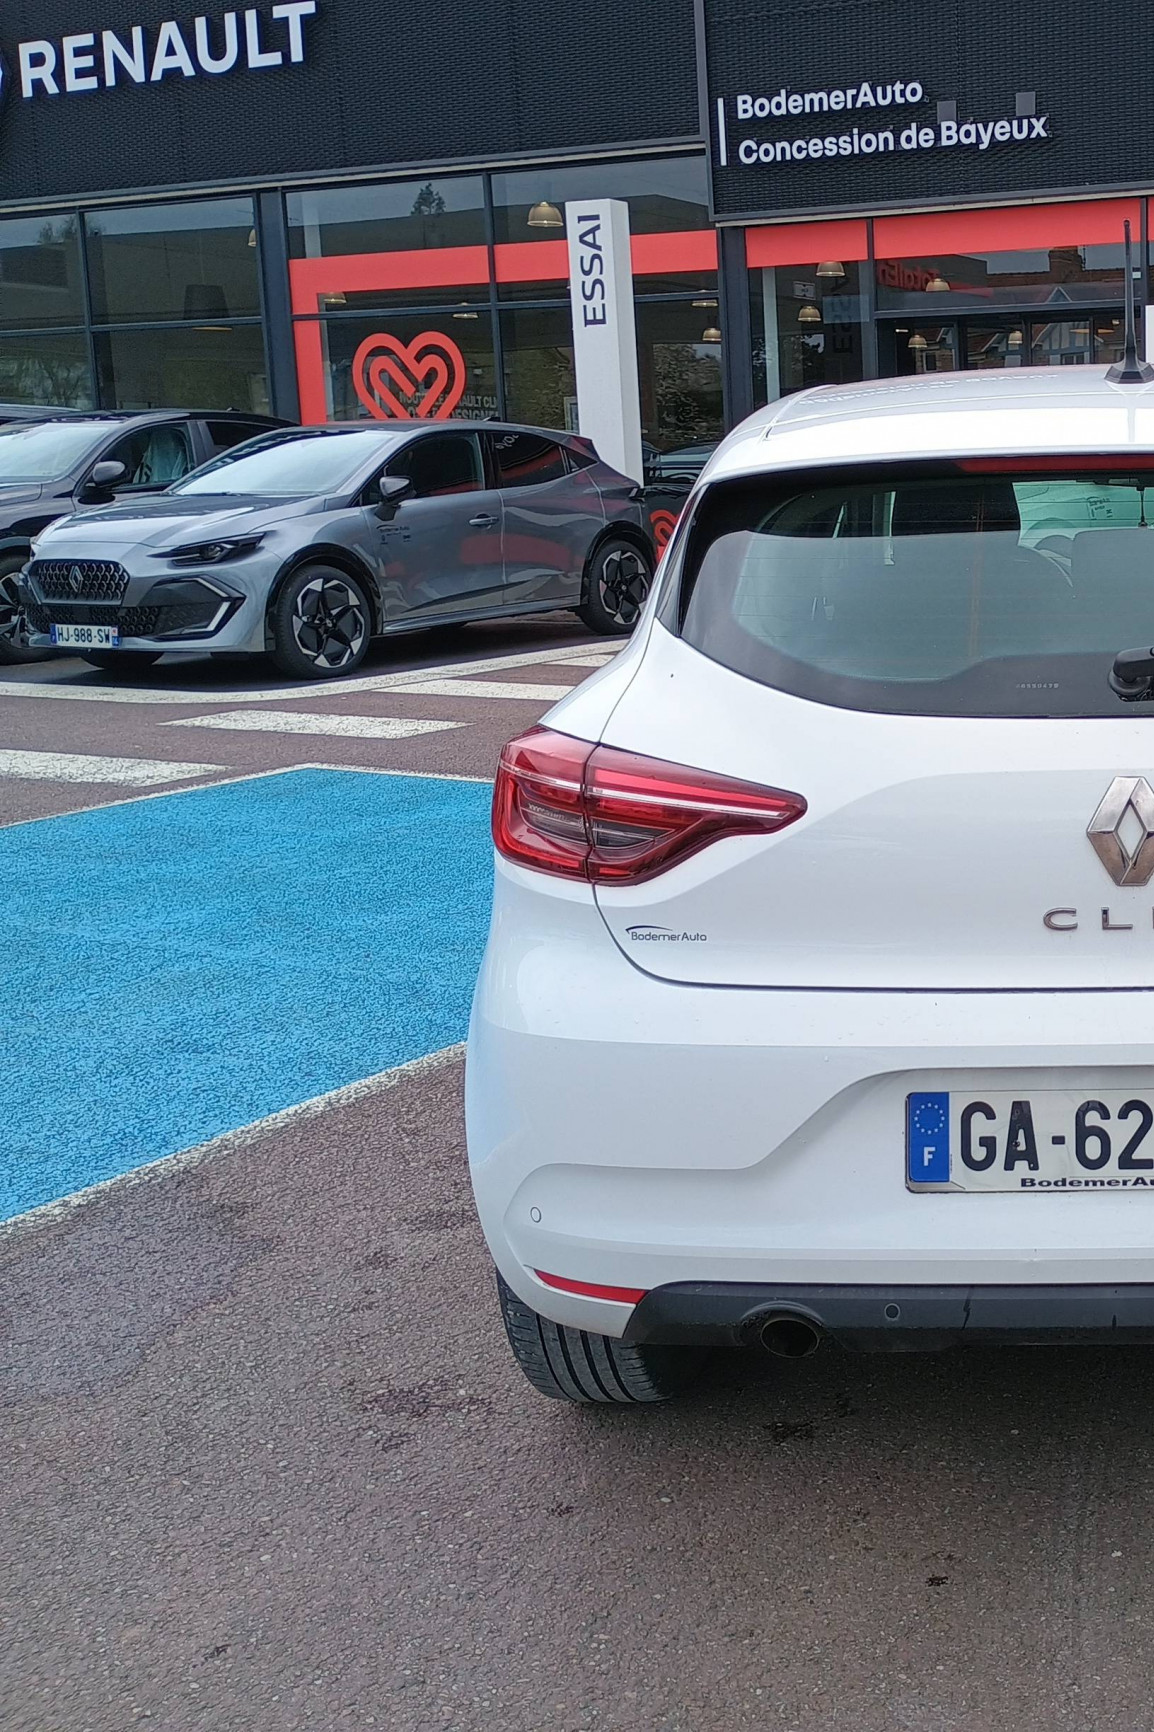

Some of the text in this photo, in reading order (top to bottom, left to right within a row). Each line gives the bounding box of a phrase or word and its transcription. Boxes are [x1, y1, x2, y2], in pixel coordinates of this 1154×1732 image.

[18, 1, 317, 99] RENAULT
[736, 79, 923, 119] BodemerAuto
[738, 115, 1048, 165] Concession de Bayeux
[577, 212, 607, 329] ESSAI
[57, 626, 110, 643] HJ-988-SW
[630, 930, 708, 942] BodemerAuto
[922, 1147, 936, 1167] F
